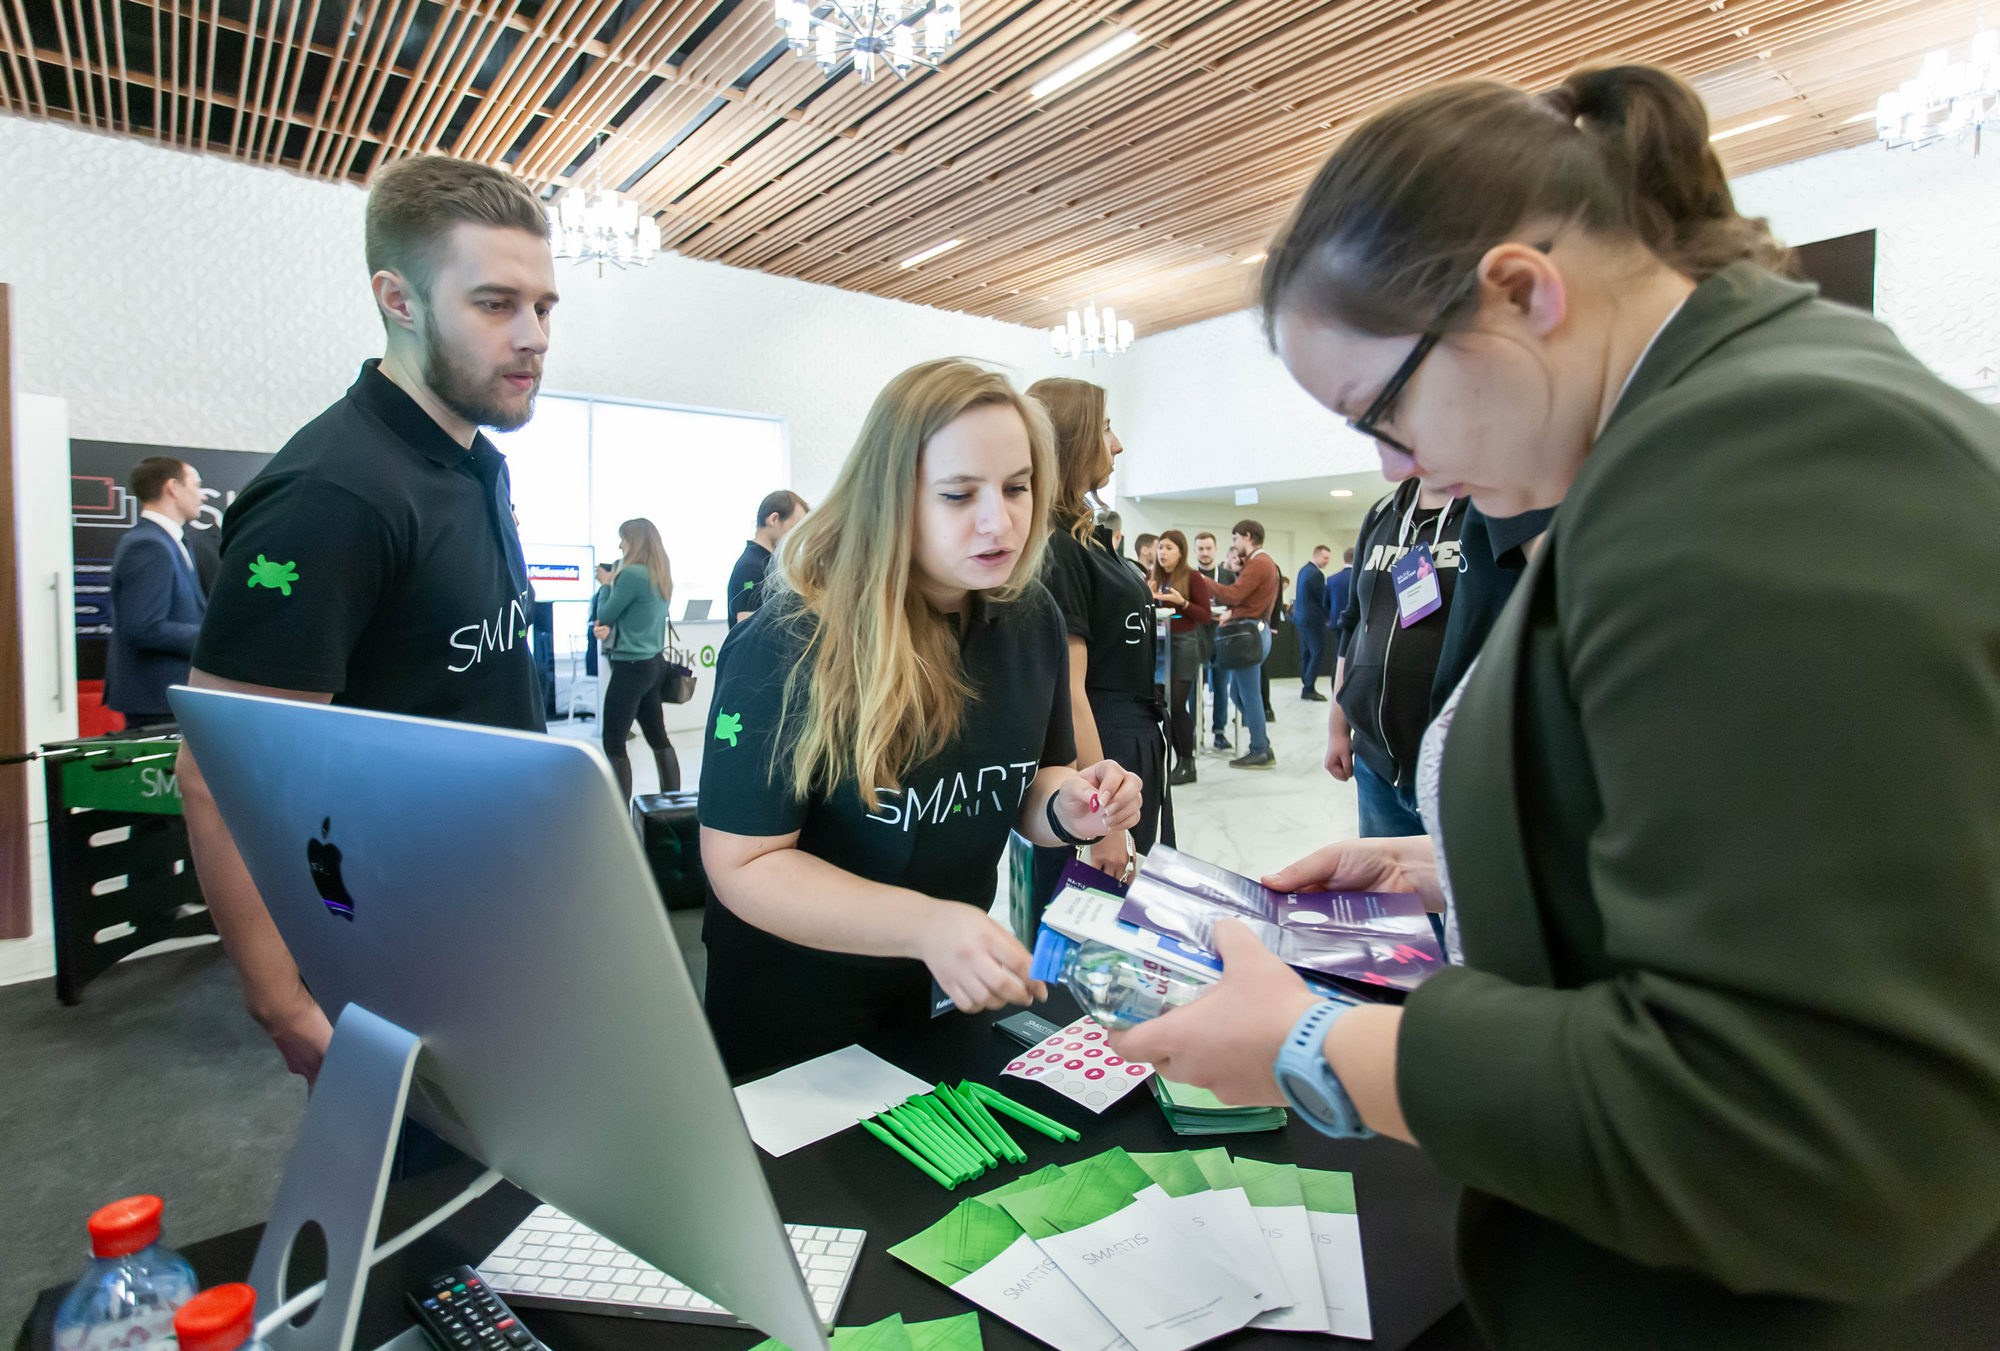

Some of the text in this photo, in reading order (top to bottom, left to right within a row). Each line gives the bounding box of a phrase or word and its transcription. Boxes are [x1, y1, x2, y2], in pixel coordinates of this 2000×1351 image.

[447, 590, 528, 673] SMA
[141, 767, 182, 798] SM
[1081, 1232, 1150, 1266] SMARTIS
[1002, 1256, 1058, 1301] SMARTIS
